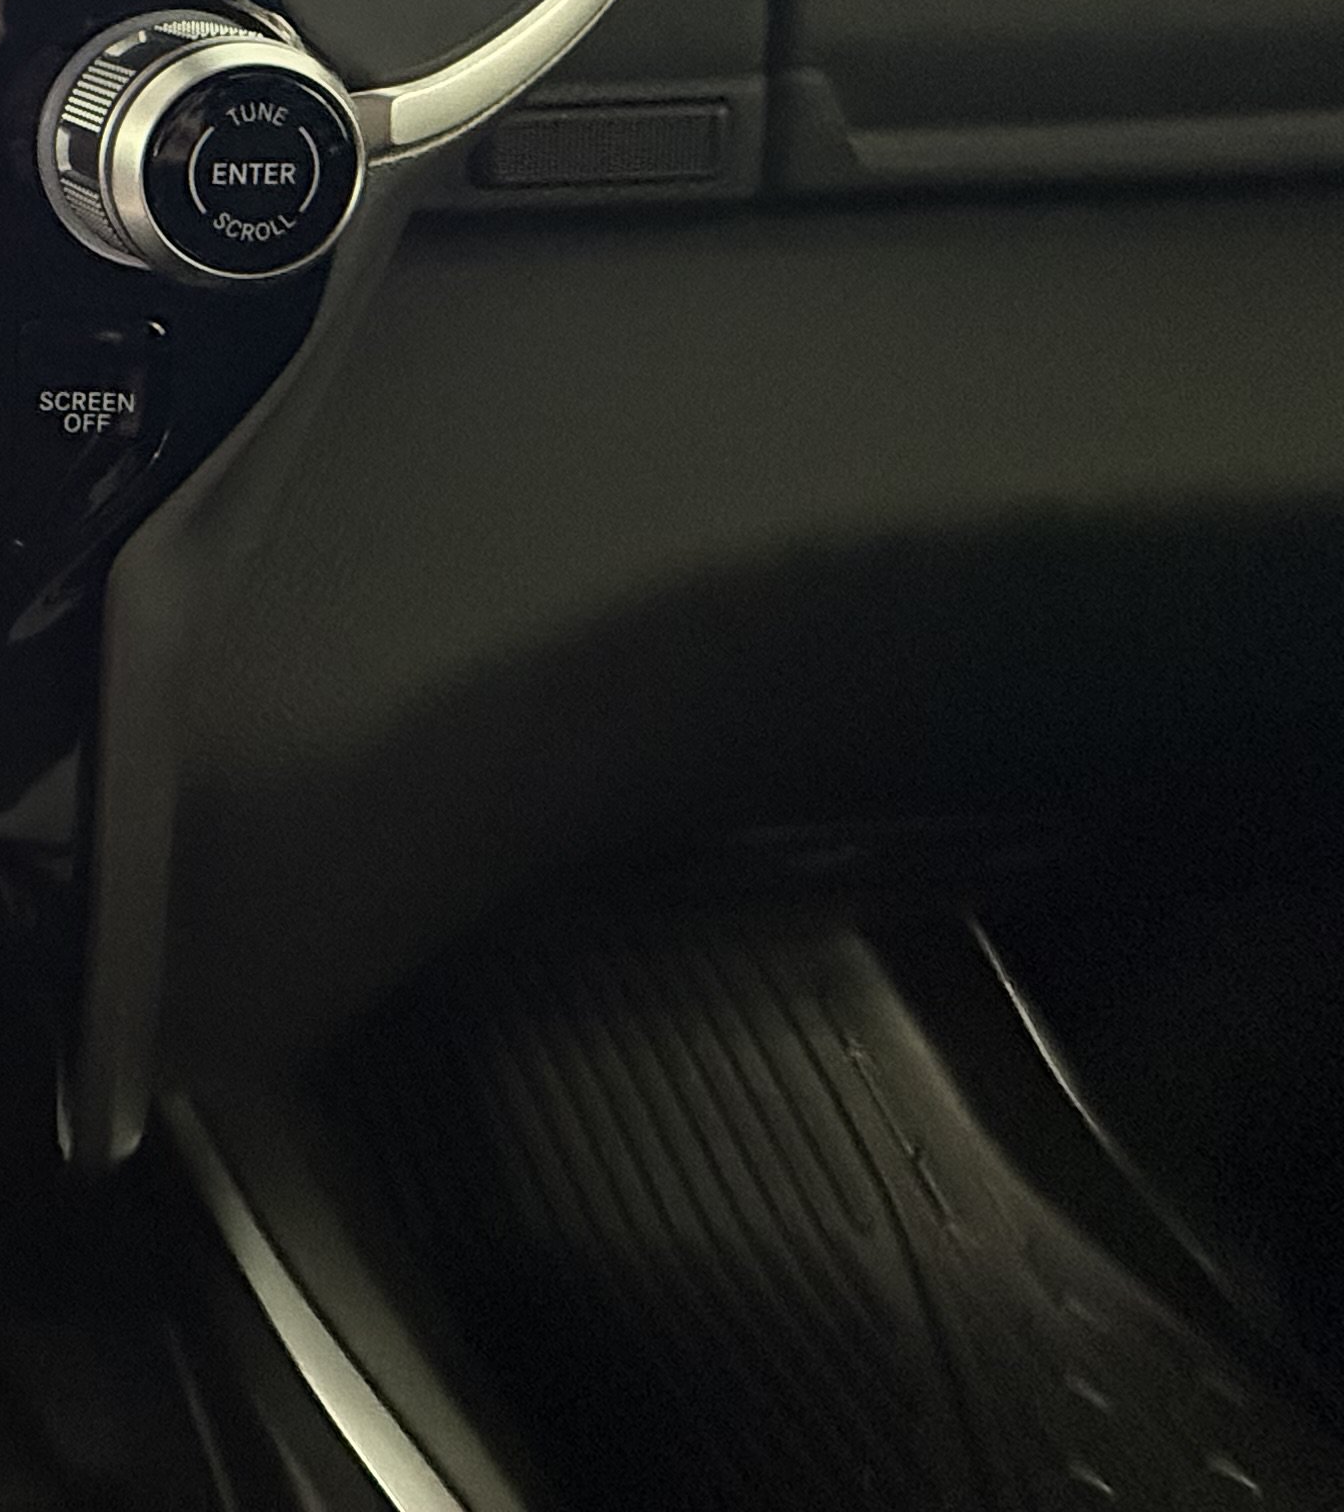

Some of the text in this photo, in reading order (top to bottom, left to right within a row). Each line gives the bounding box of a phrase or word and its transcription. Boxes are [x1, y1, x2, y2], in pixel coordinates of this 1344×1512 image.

[225, 101, 290, 128] TUNE
[211, 162, 297, 186] ENTER
[212, 211, 297, 243] SCROLL
[38, 390, 136, 414] SCREEN
[63, 413, 112, 434] OFF
